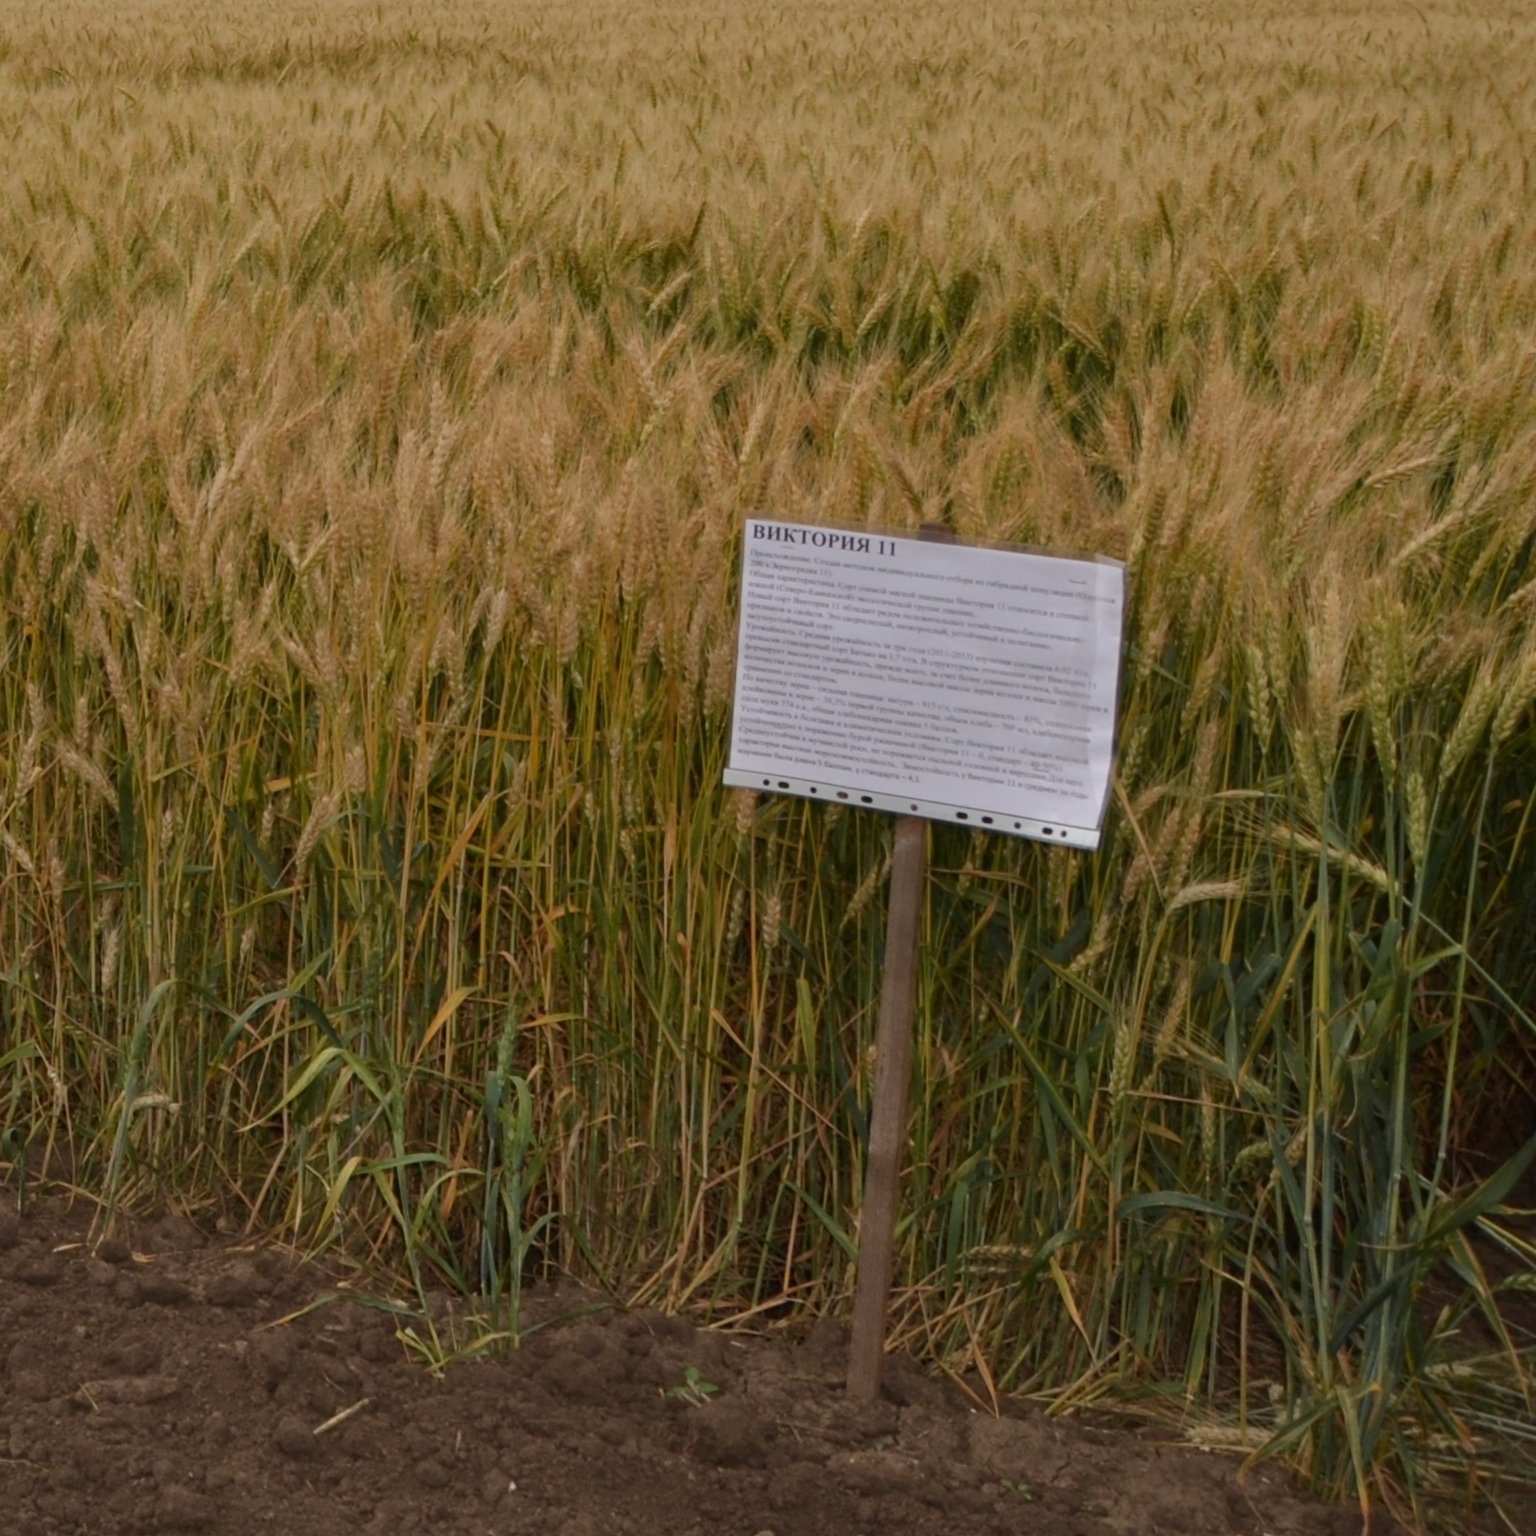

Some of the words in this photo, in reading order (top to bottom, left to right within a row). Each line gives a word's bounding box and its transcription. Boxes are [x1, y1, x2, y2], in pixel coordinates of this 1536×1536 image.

[751, 523, 871, 553] ВИКТОРИЯ
[877, 538, 897, 556] 11
[793, 595, 829, 609] Виктория
[955, 595, 994, 610] Виктория
